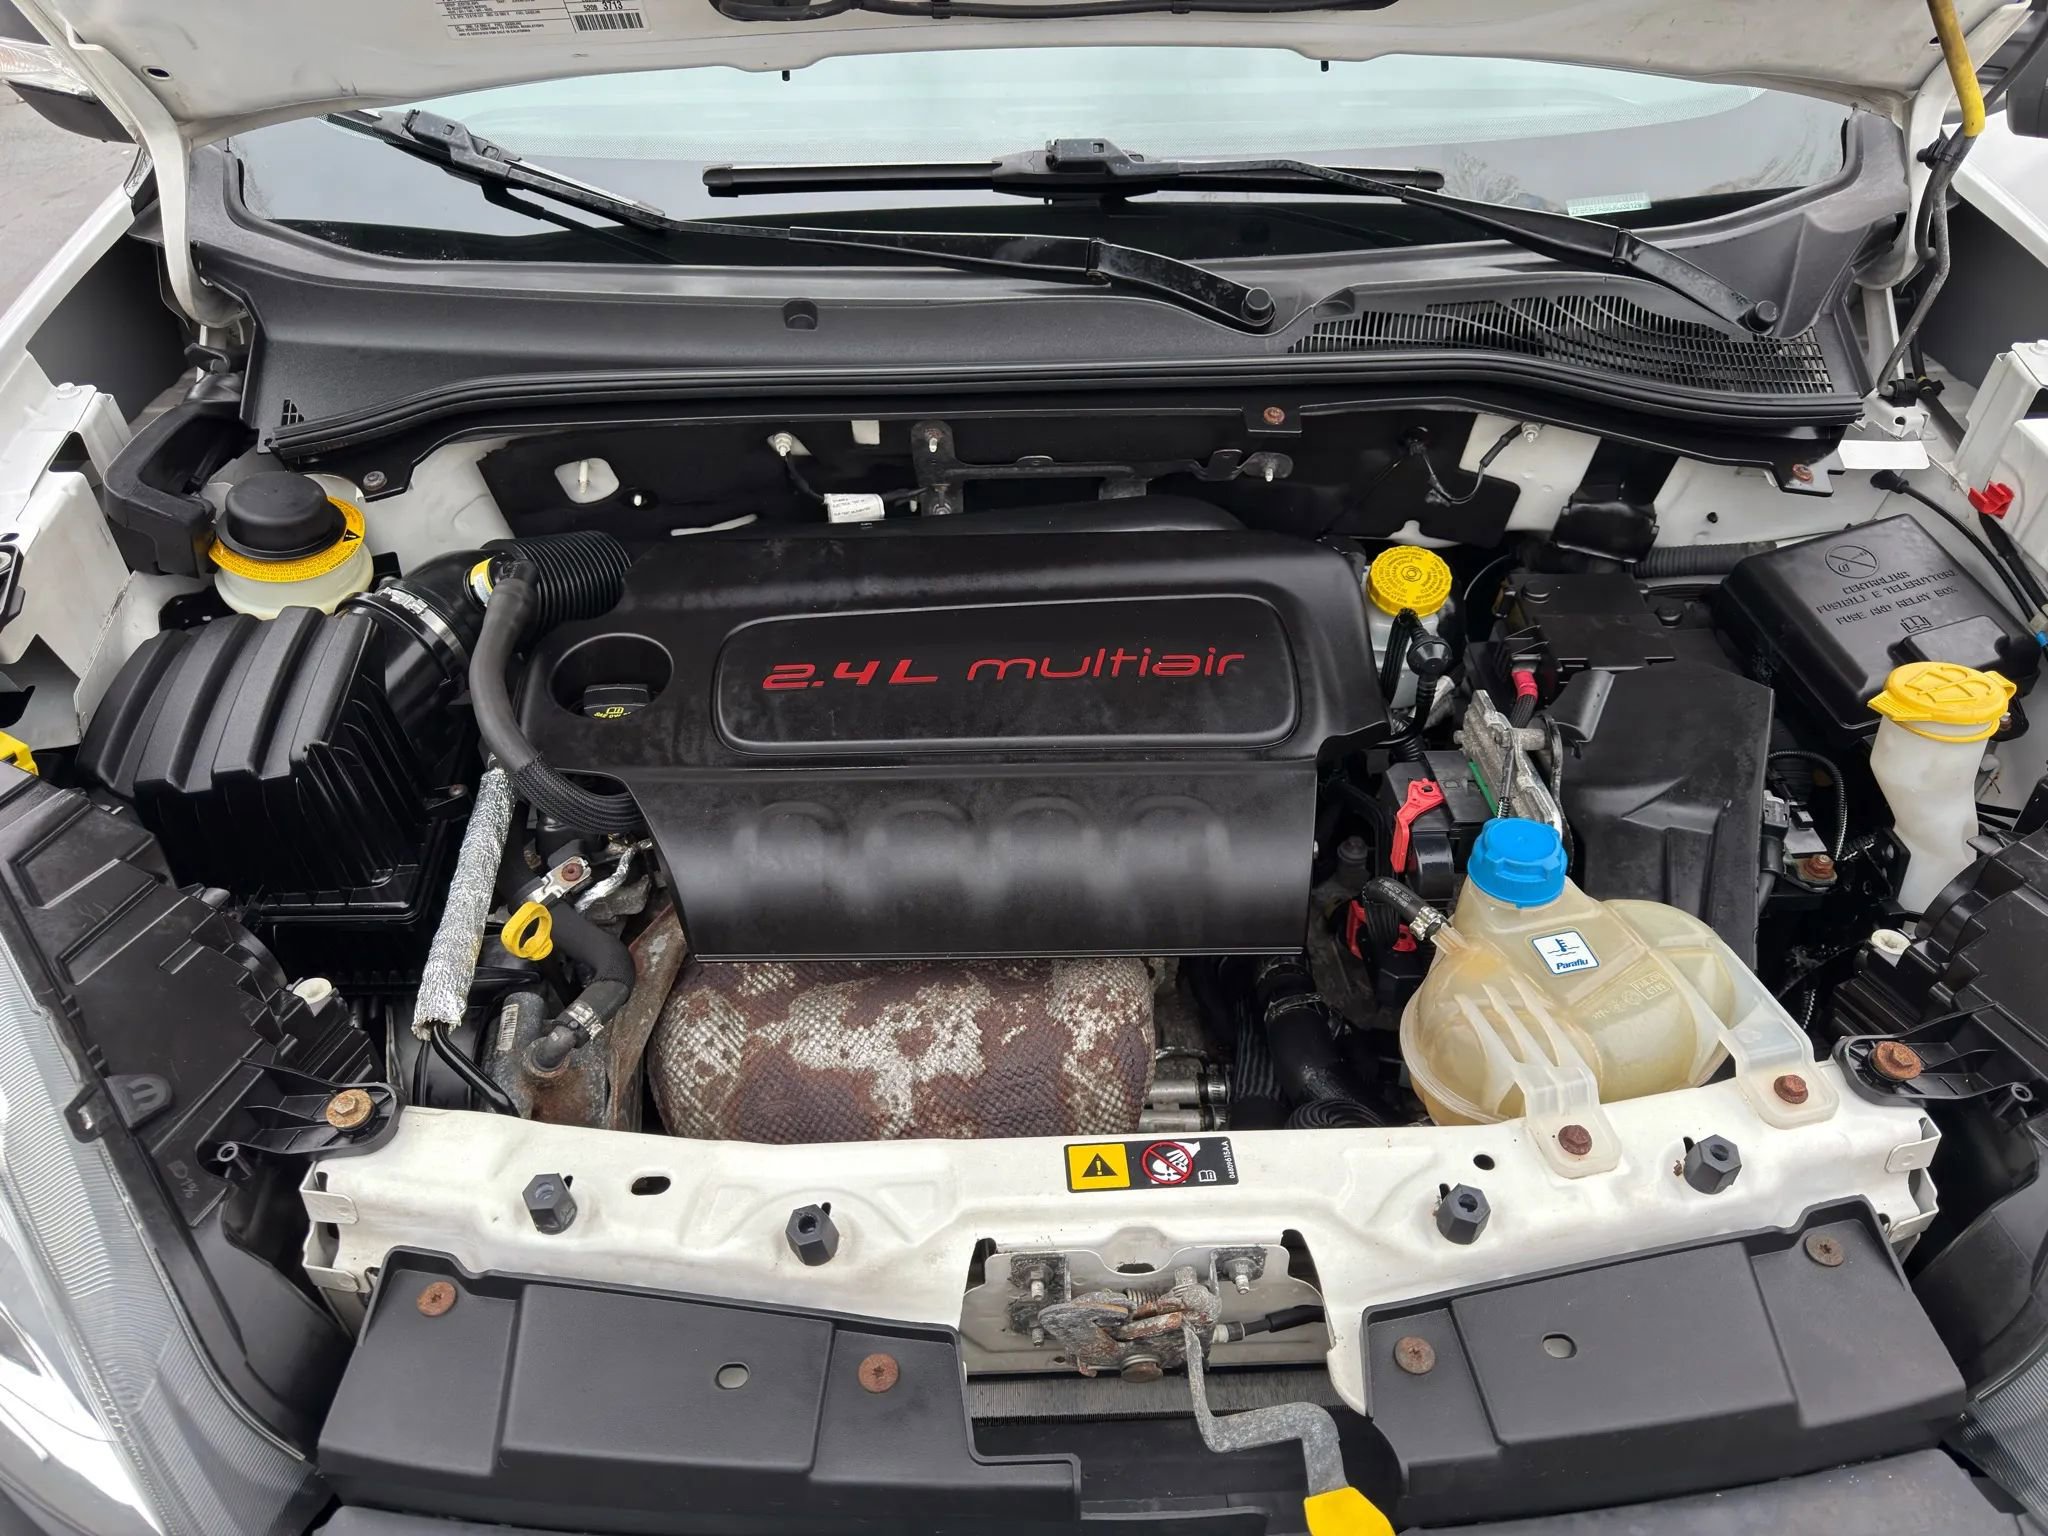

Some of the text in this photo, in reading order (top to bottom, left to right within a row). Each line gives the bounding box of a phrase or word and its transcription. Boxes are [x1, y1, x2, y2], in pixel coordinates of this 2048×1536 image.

[602, 0, 623, 10] 3713
[1836, 585, 1959, 625] FUSE AND RELAY BOX
[967, 646, 1245, 681] multiair
[1556, 958, 1588, 970] Paraflu
